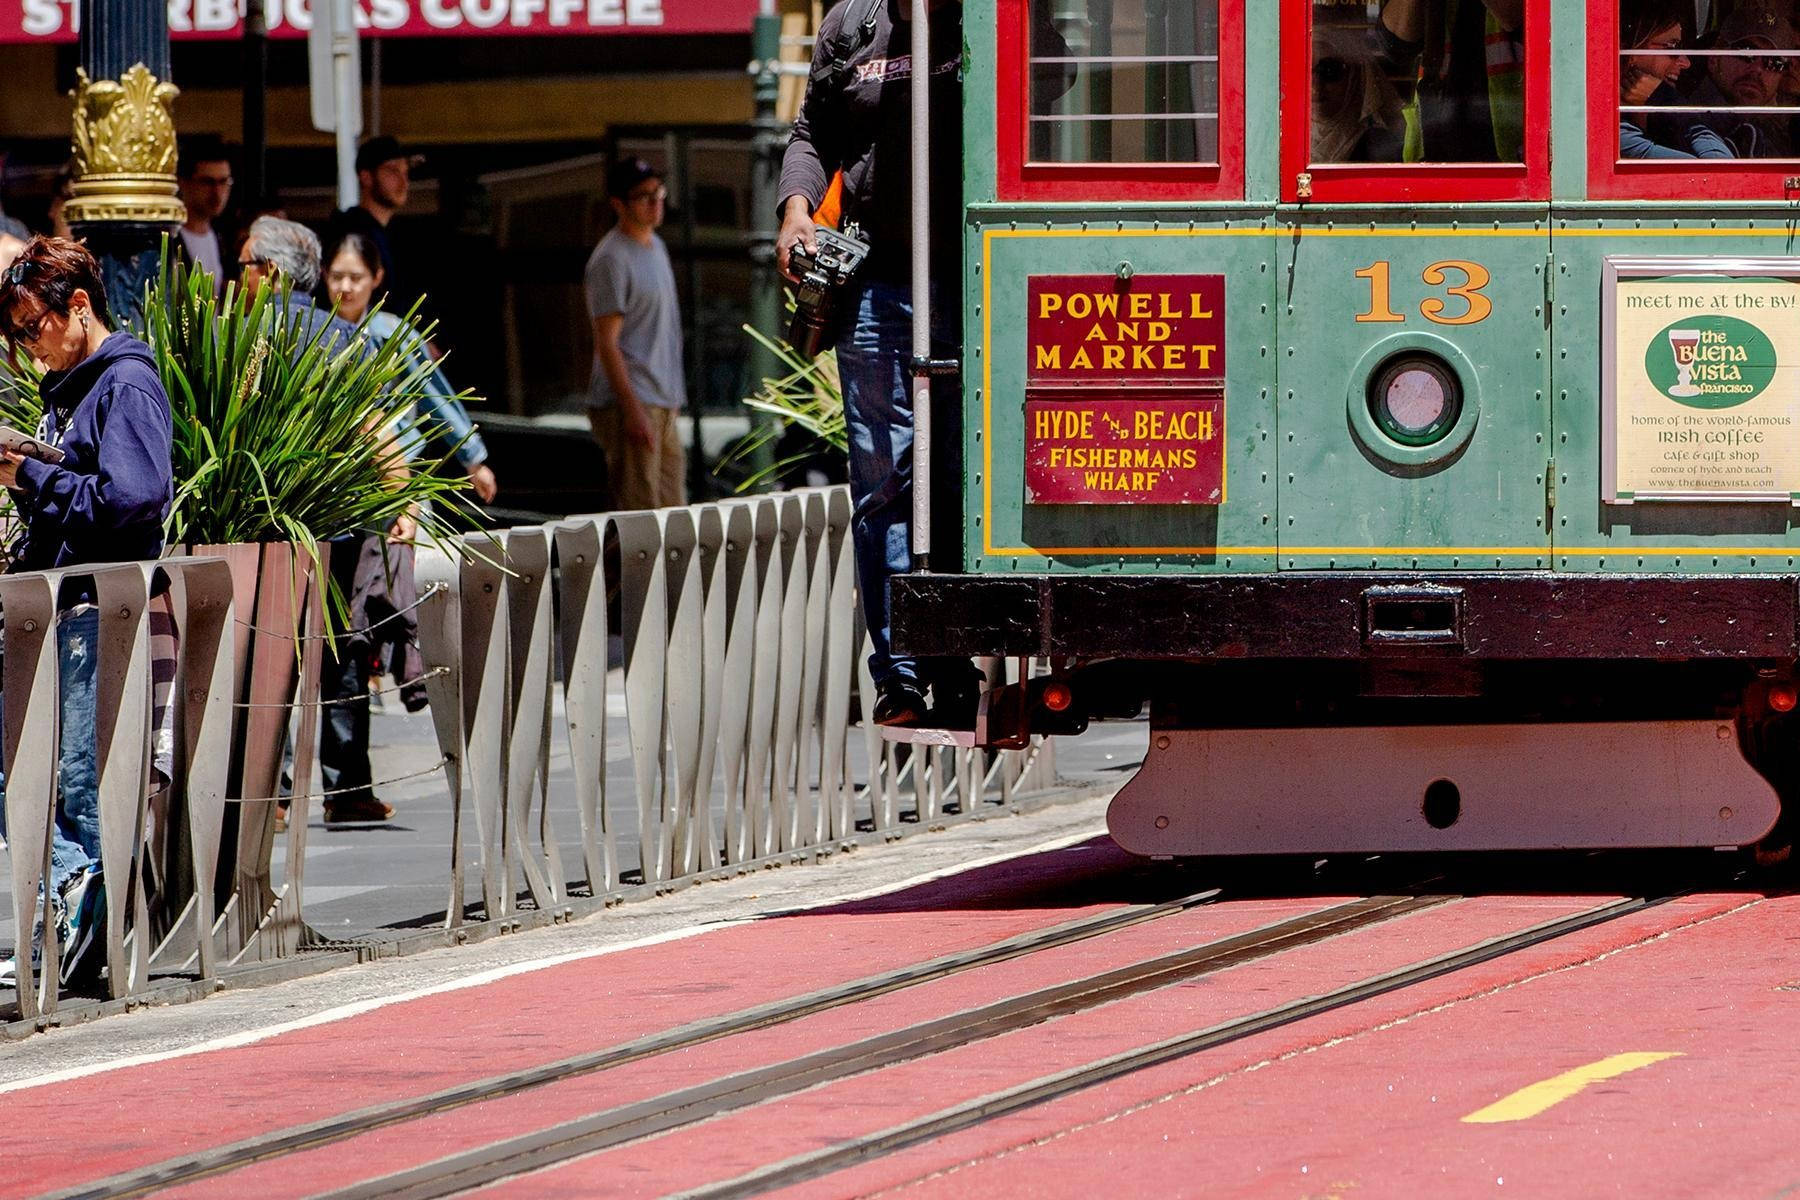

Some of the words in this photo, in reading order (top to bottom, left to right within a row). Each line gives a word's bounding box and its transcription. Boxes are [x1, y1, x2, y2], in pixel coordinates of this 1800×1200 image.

[1355, 260, 1492, 325] 13
[1735, 293, 1765, 308] the
[1039, 293, 1213, 319] POWELL
[1085, 322, 1171, 341] AND
[1701, 329, 1727, 344] the
[1036, 345, 1216, 369] MARKET
[1035, 410, 1094, 439] HYDE
[1102, 412, 1129, 439] AND
[1135, 411, 1212, 440] BEACH
[1684, 415, 1703, 425] the
[1050, 448, 1197, 468] FISHERMANS
[1693, 452, 1701, 460] &
[1729, 450, 1760, 462] shop
[1084, 471, 1160, 491] WHARF
